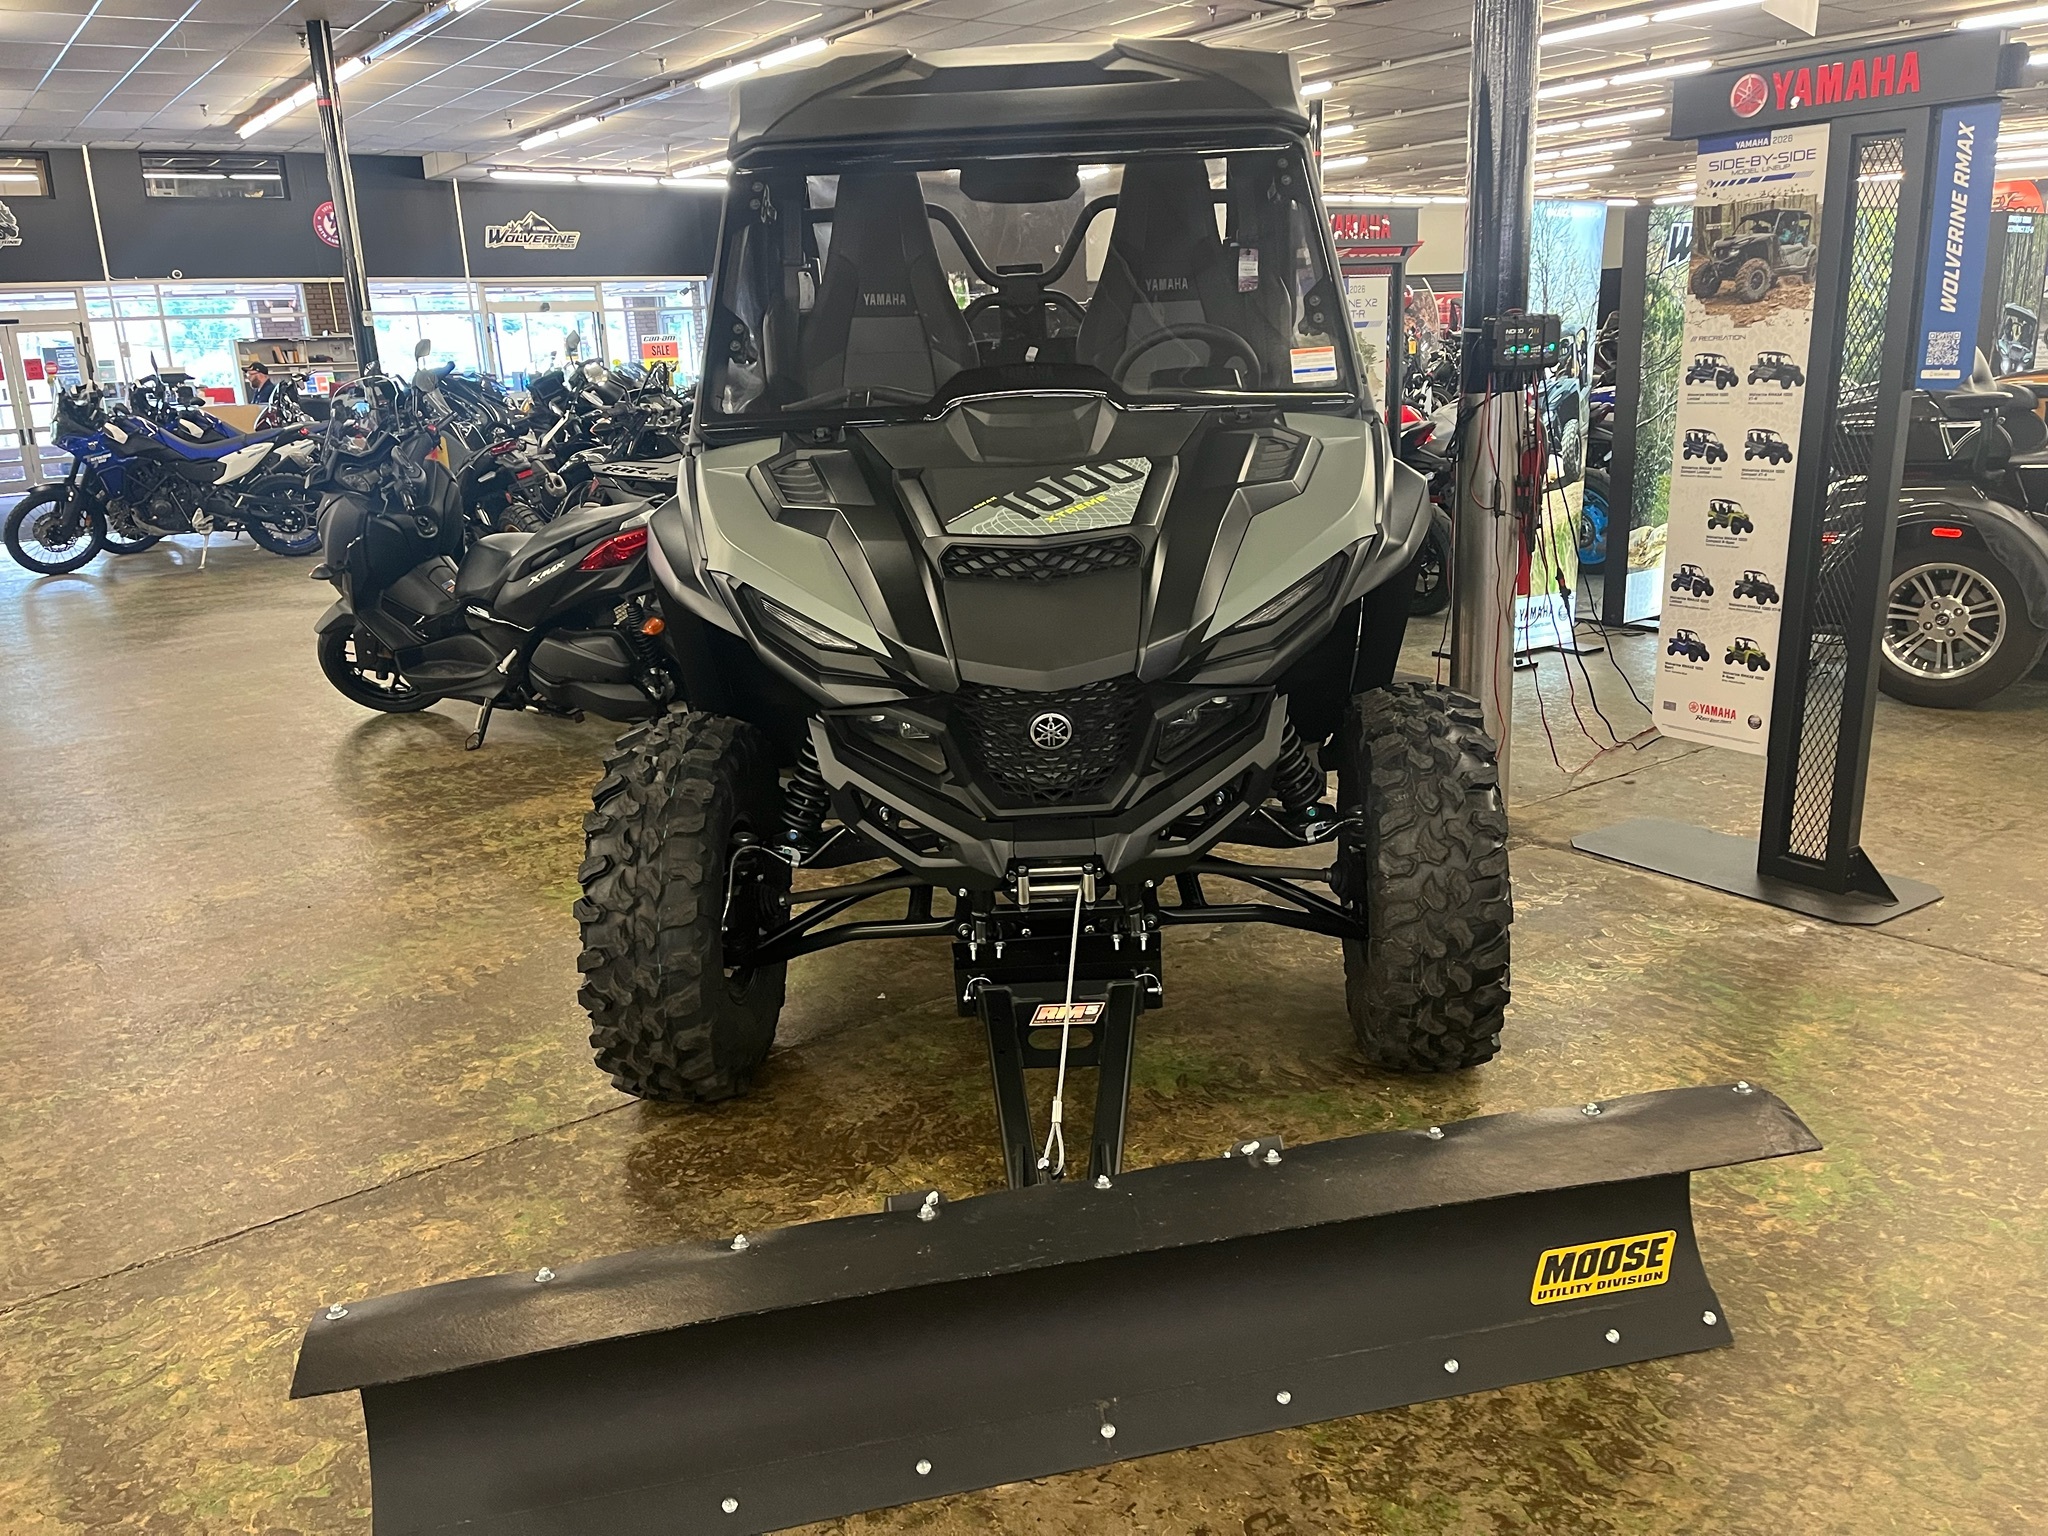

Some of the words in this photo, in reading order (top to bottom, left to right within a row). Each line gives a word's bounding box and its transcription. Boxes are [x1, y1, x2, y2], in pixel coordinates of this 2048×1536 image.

[1773, 51, 1920, 110] YAMAHA
[1735, 137, 1770, 150] YAMAHA
[1708, 148, 1818, 172] SIDE-BY-SIDE
[1953, 120, 1976, 189] RMAX
[1731, 167, 1760, 176] MODEL
[1761, 163, 1792, 173] LINEUP
[488, 228, 577, 244] WOLVERINE
[1938, 190, 1969, 313] WOLVERINE
[1144, 277, 1189, 292] YAMAHA
[1349, 284, 1366, 294] 2026
[863, 293, 907, 307] YAMAHA
[1364, 298, 1378, 308] X2
[1698, 333, 1747, 342] RECREATION
[651, 345, 671, 357] SALE
[990, 460, 1146, 520] 1000
[1045, 493, 1109, 524] XTREME
[527, 559, 566, 588] XMAX
[1700, 703, 1737, 720] YAMAHA
[1540, 1237, 1669, 1286] MOOSE
[1537, 1283, 1593, 1300] UTILITY
[1596, 1271, 1664, 1290] DIVISION
